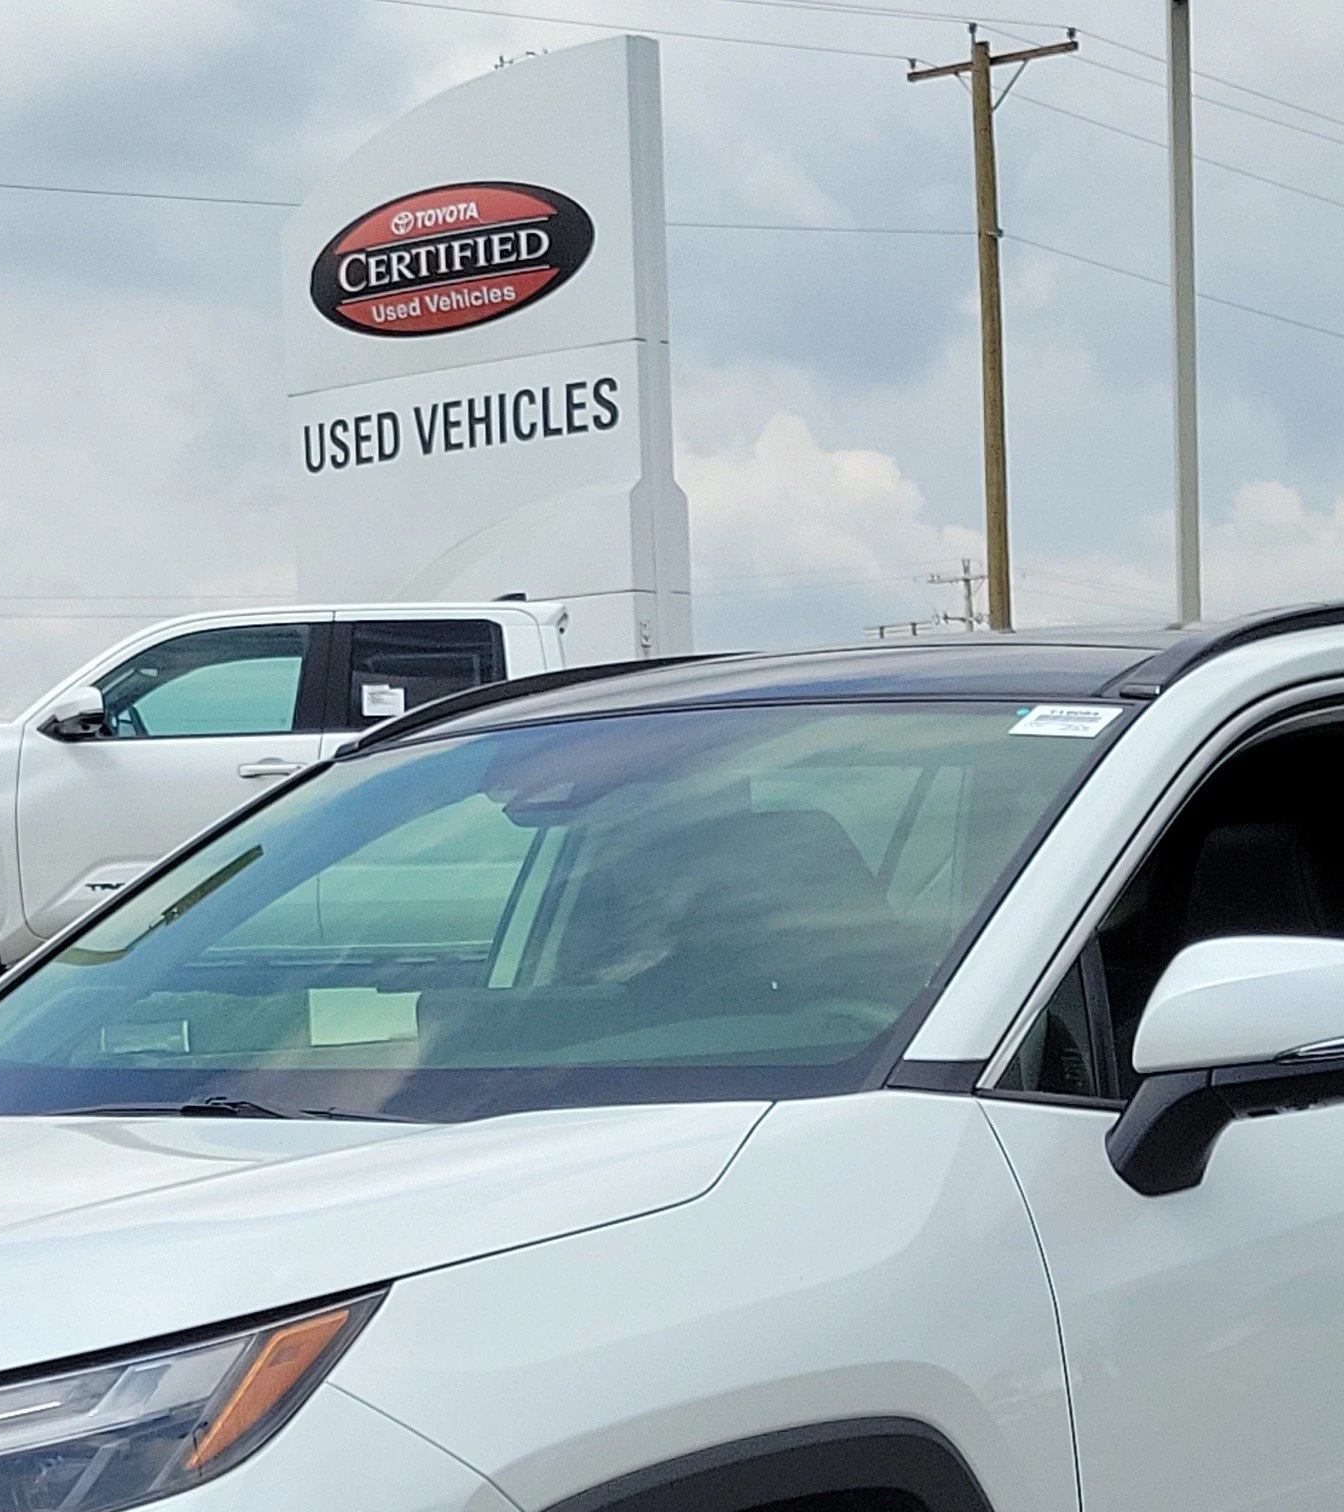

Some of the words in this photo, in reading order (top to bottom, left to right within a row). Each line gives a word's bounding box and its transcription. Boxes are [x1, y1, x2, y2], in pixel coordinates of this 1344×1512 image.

[416, 203, 480, 229] TOYOTA
[337, 229, 550, 292] CERTIFIED
[372, 300, 421, 323] Used
[425, 284, 516, 314] Vehicles
[304, 411, 400, 474] USED
[414, 377, 619, 456] VEHICLES
